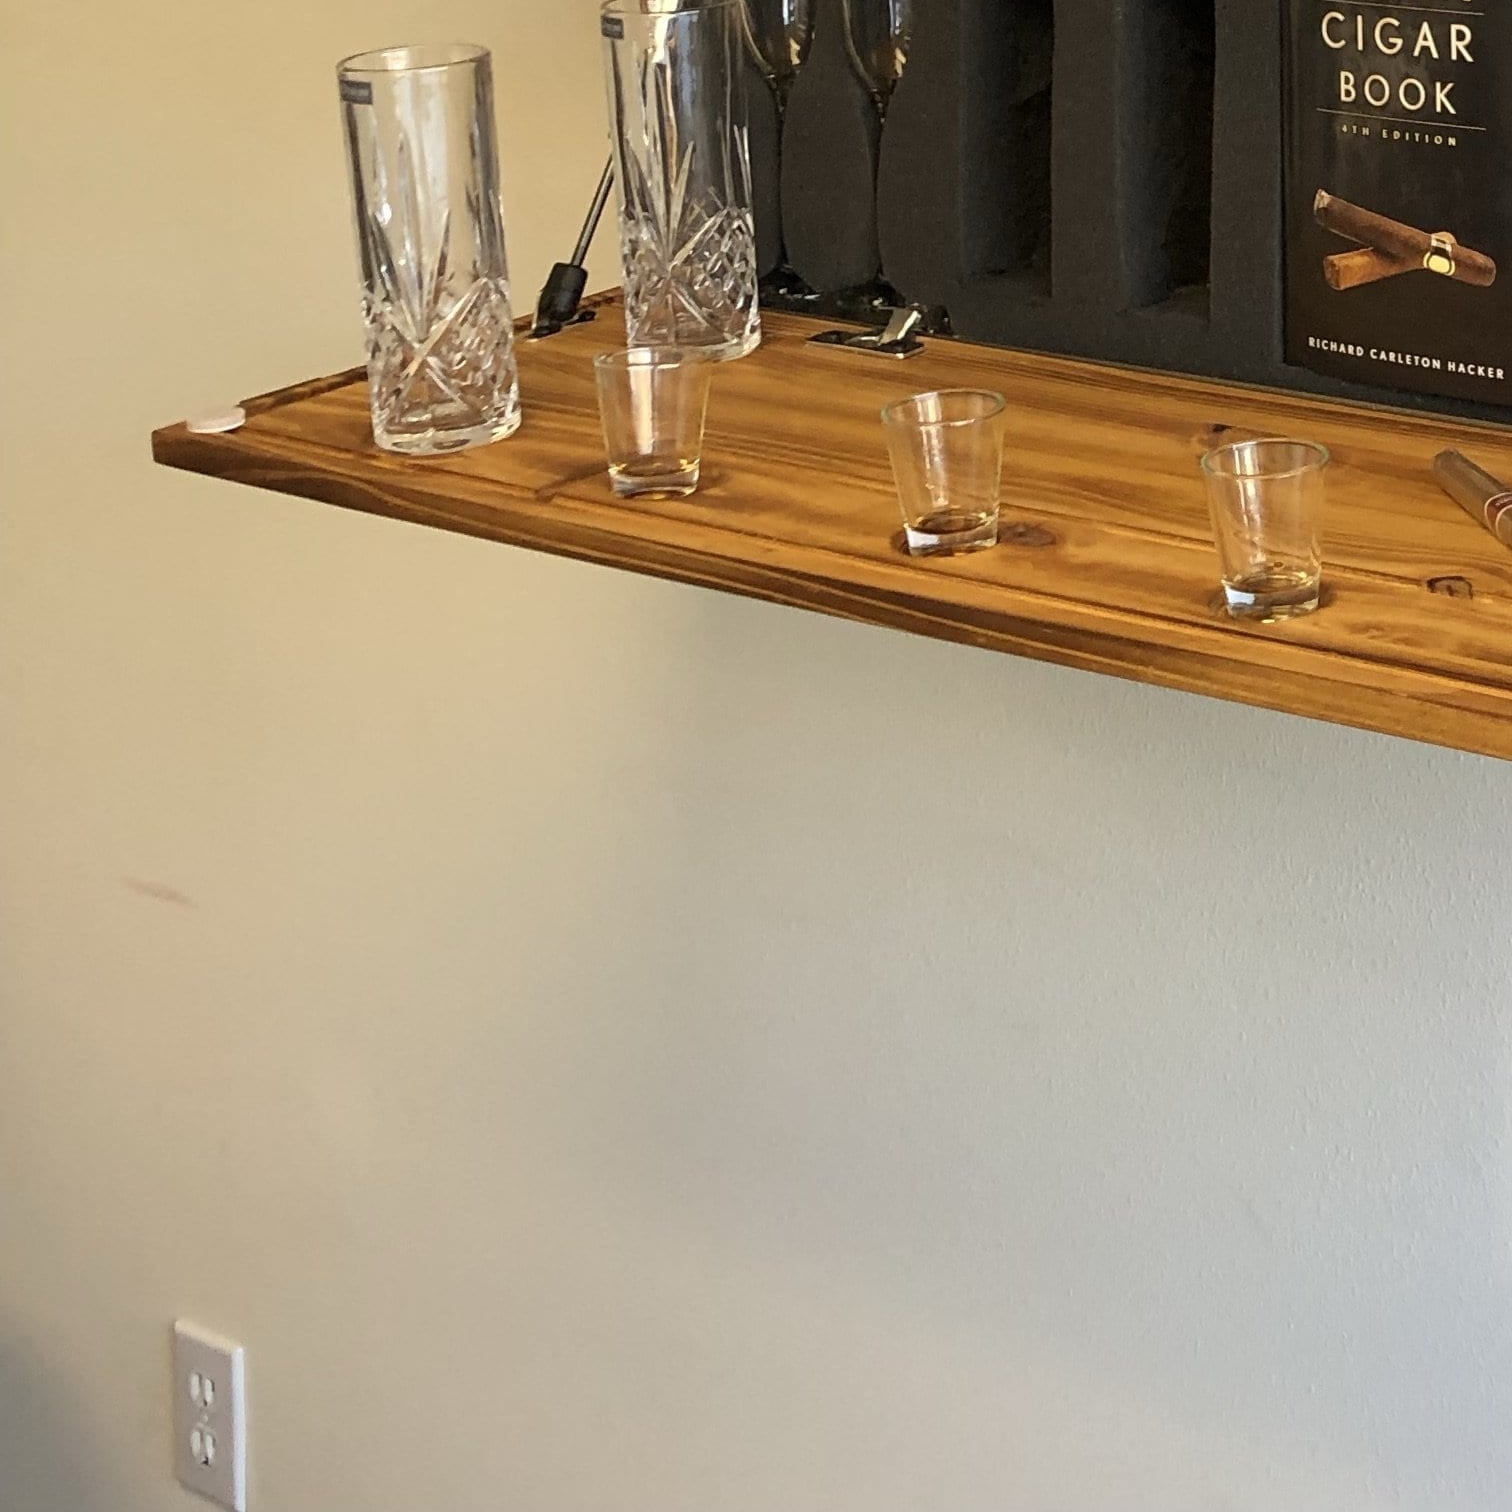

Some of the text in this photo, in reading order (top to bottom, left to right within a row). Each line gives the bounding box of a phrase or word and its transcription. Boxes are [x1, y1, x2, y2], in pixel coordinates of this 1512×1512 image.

[1321, 11, 1475, 63] CIGAR
[1339, 70, 1457, 115] BOOK
[1342, 123, 1457, 147] 4TH EDITION
[1308, 336, 1505, 380] RICHARD CARLETON HACKER
